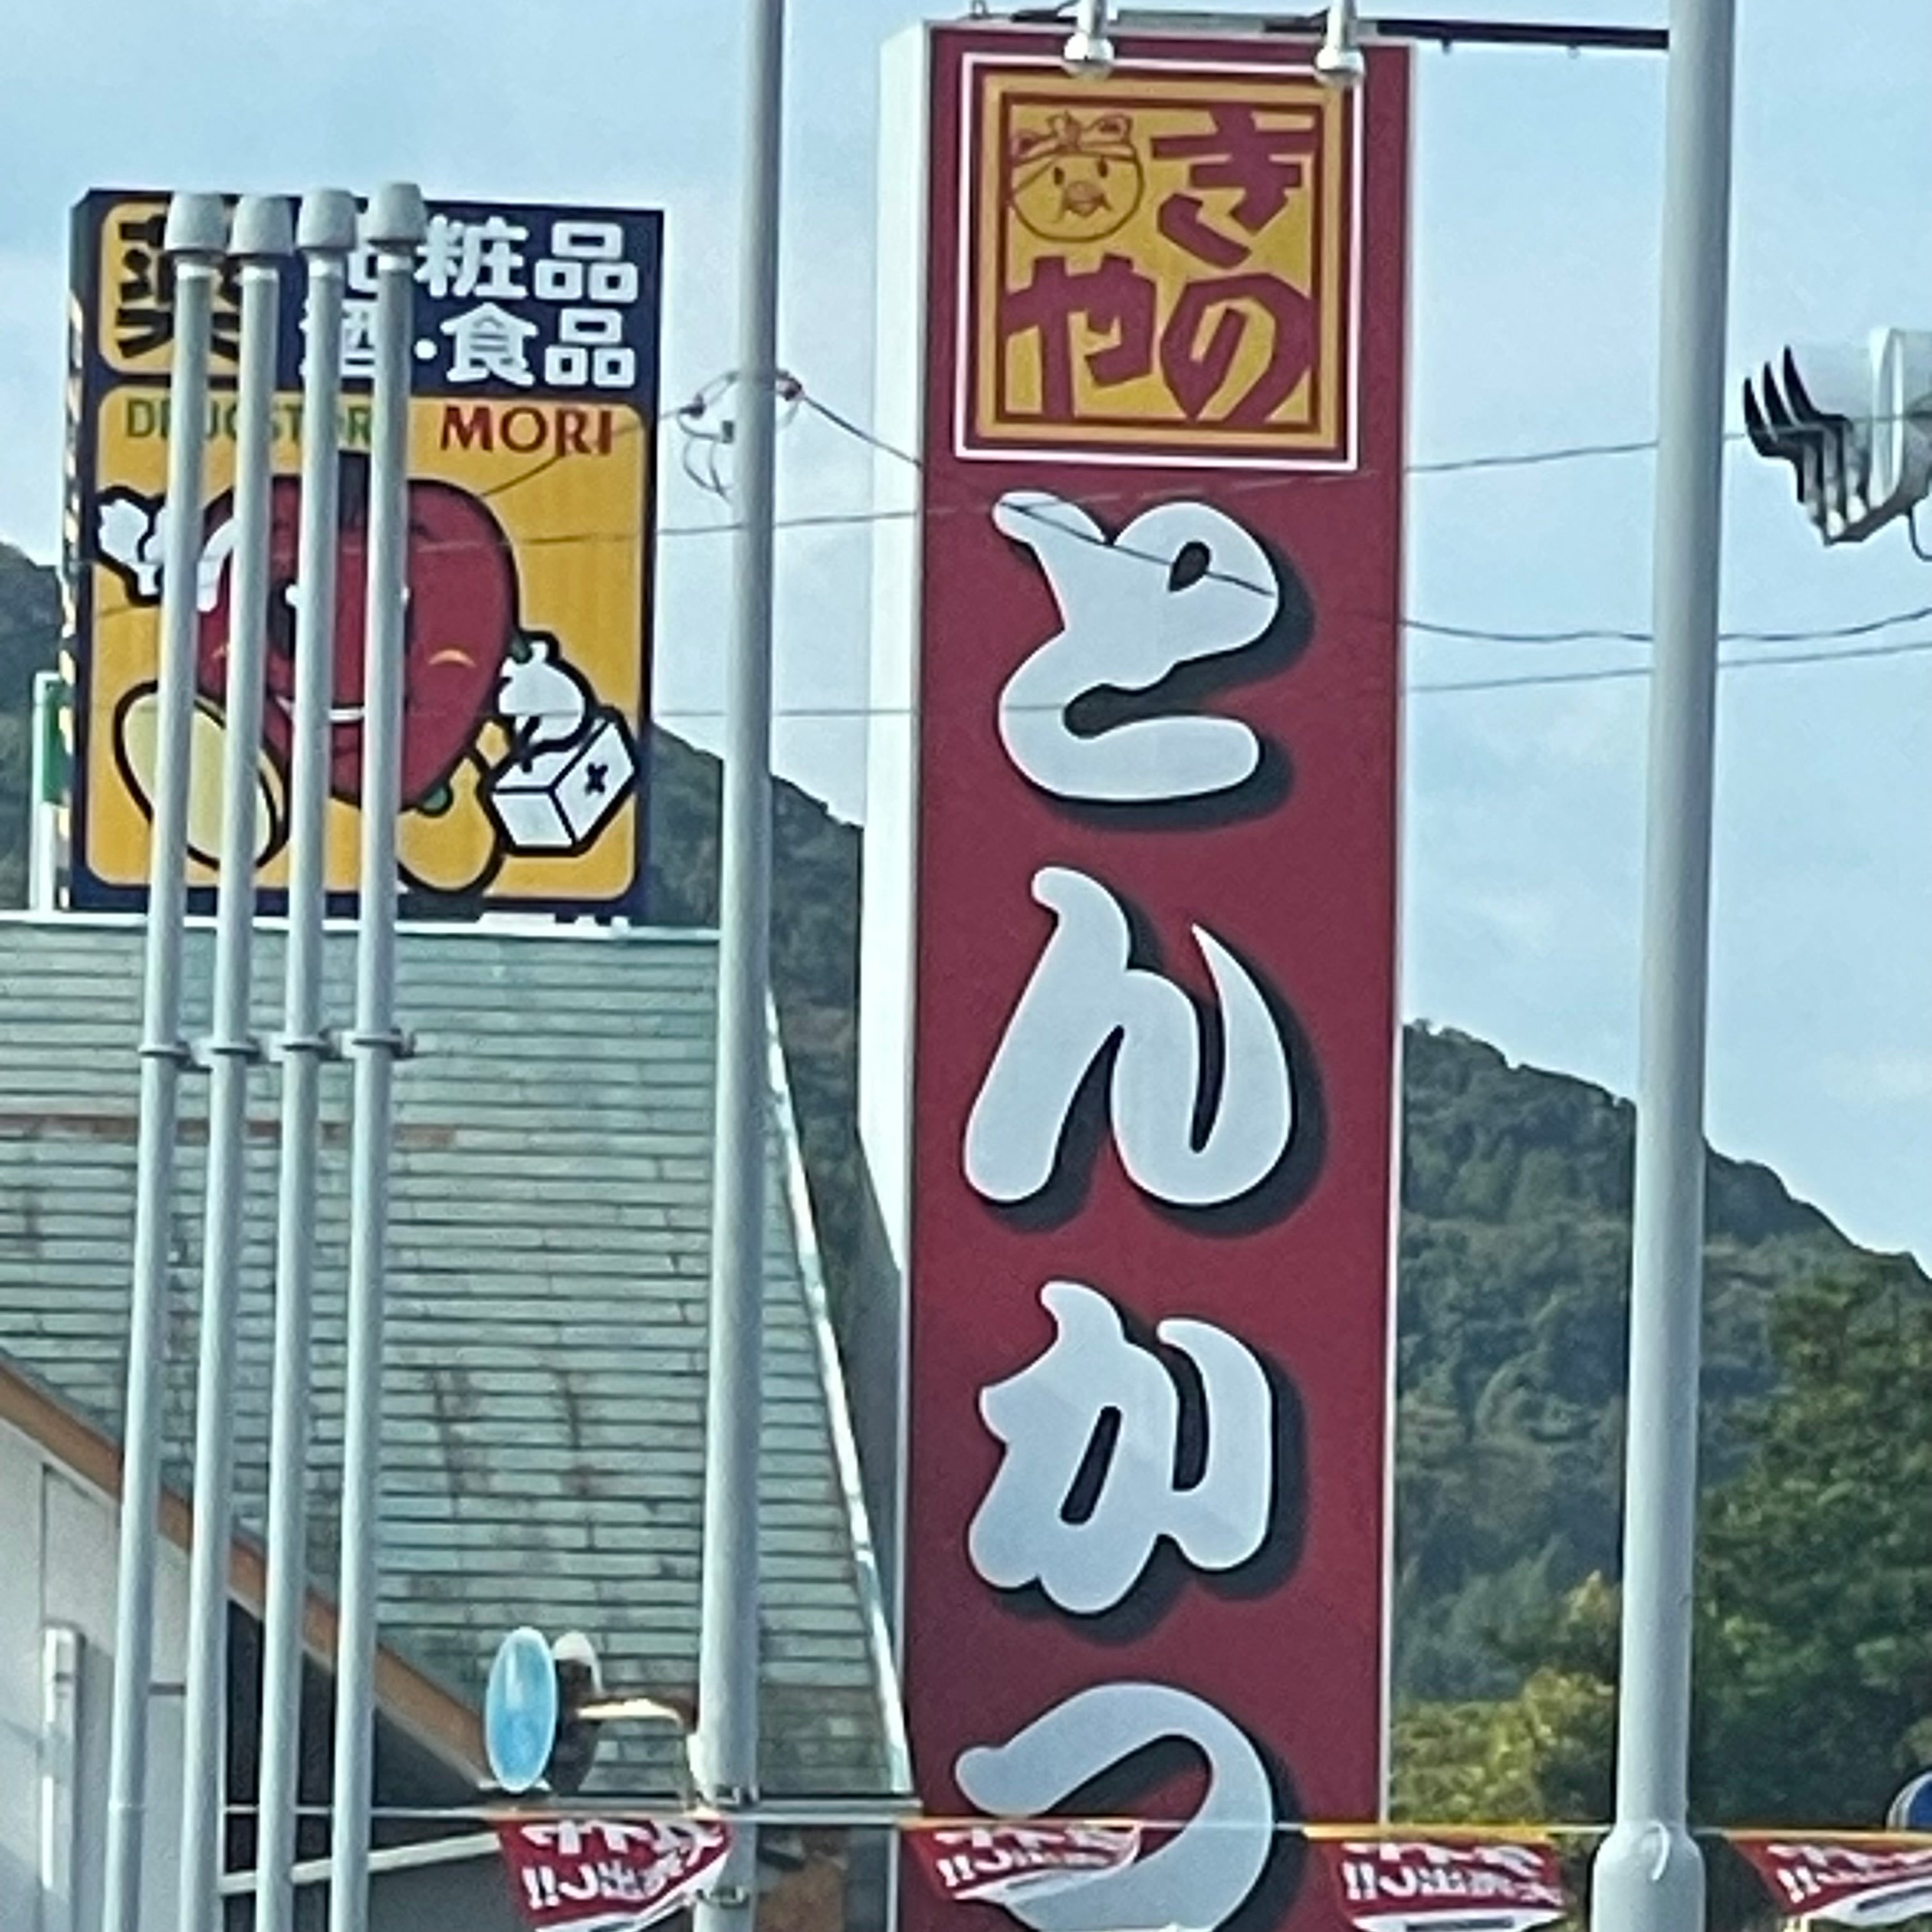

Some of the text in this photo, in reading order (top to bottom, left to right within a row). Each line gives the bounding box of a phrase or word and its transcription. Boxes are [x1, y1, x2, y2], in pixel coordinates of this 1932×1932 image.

[440, 405, 613, 456] MORI
[954, 491, 1293, 1932] とんかつ
